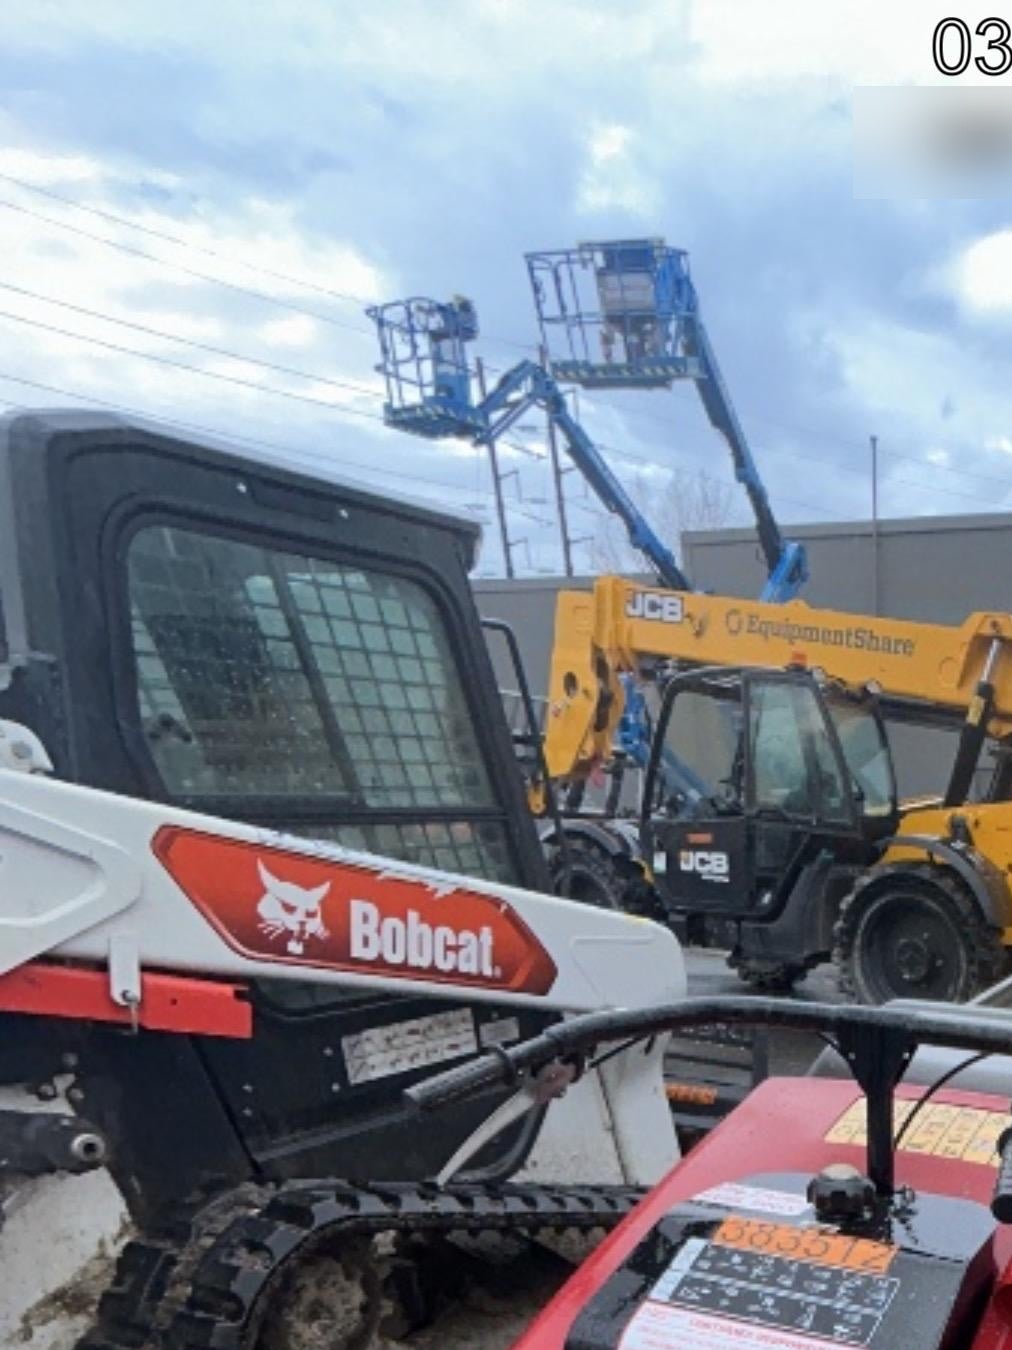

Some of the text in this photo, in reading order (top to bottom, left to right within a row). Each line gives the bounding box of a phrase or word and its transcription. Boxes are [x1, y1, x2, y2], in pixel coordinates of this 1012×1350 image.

[625, 590, 684, 624] JCB
[745, 614, 916, 657] EquipmentShare
[679, 850, 729, 874] JCB
